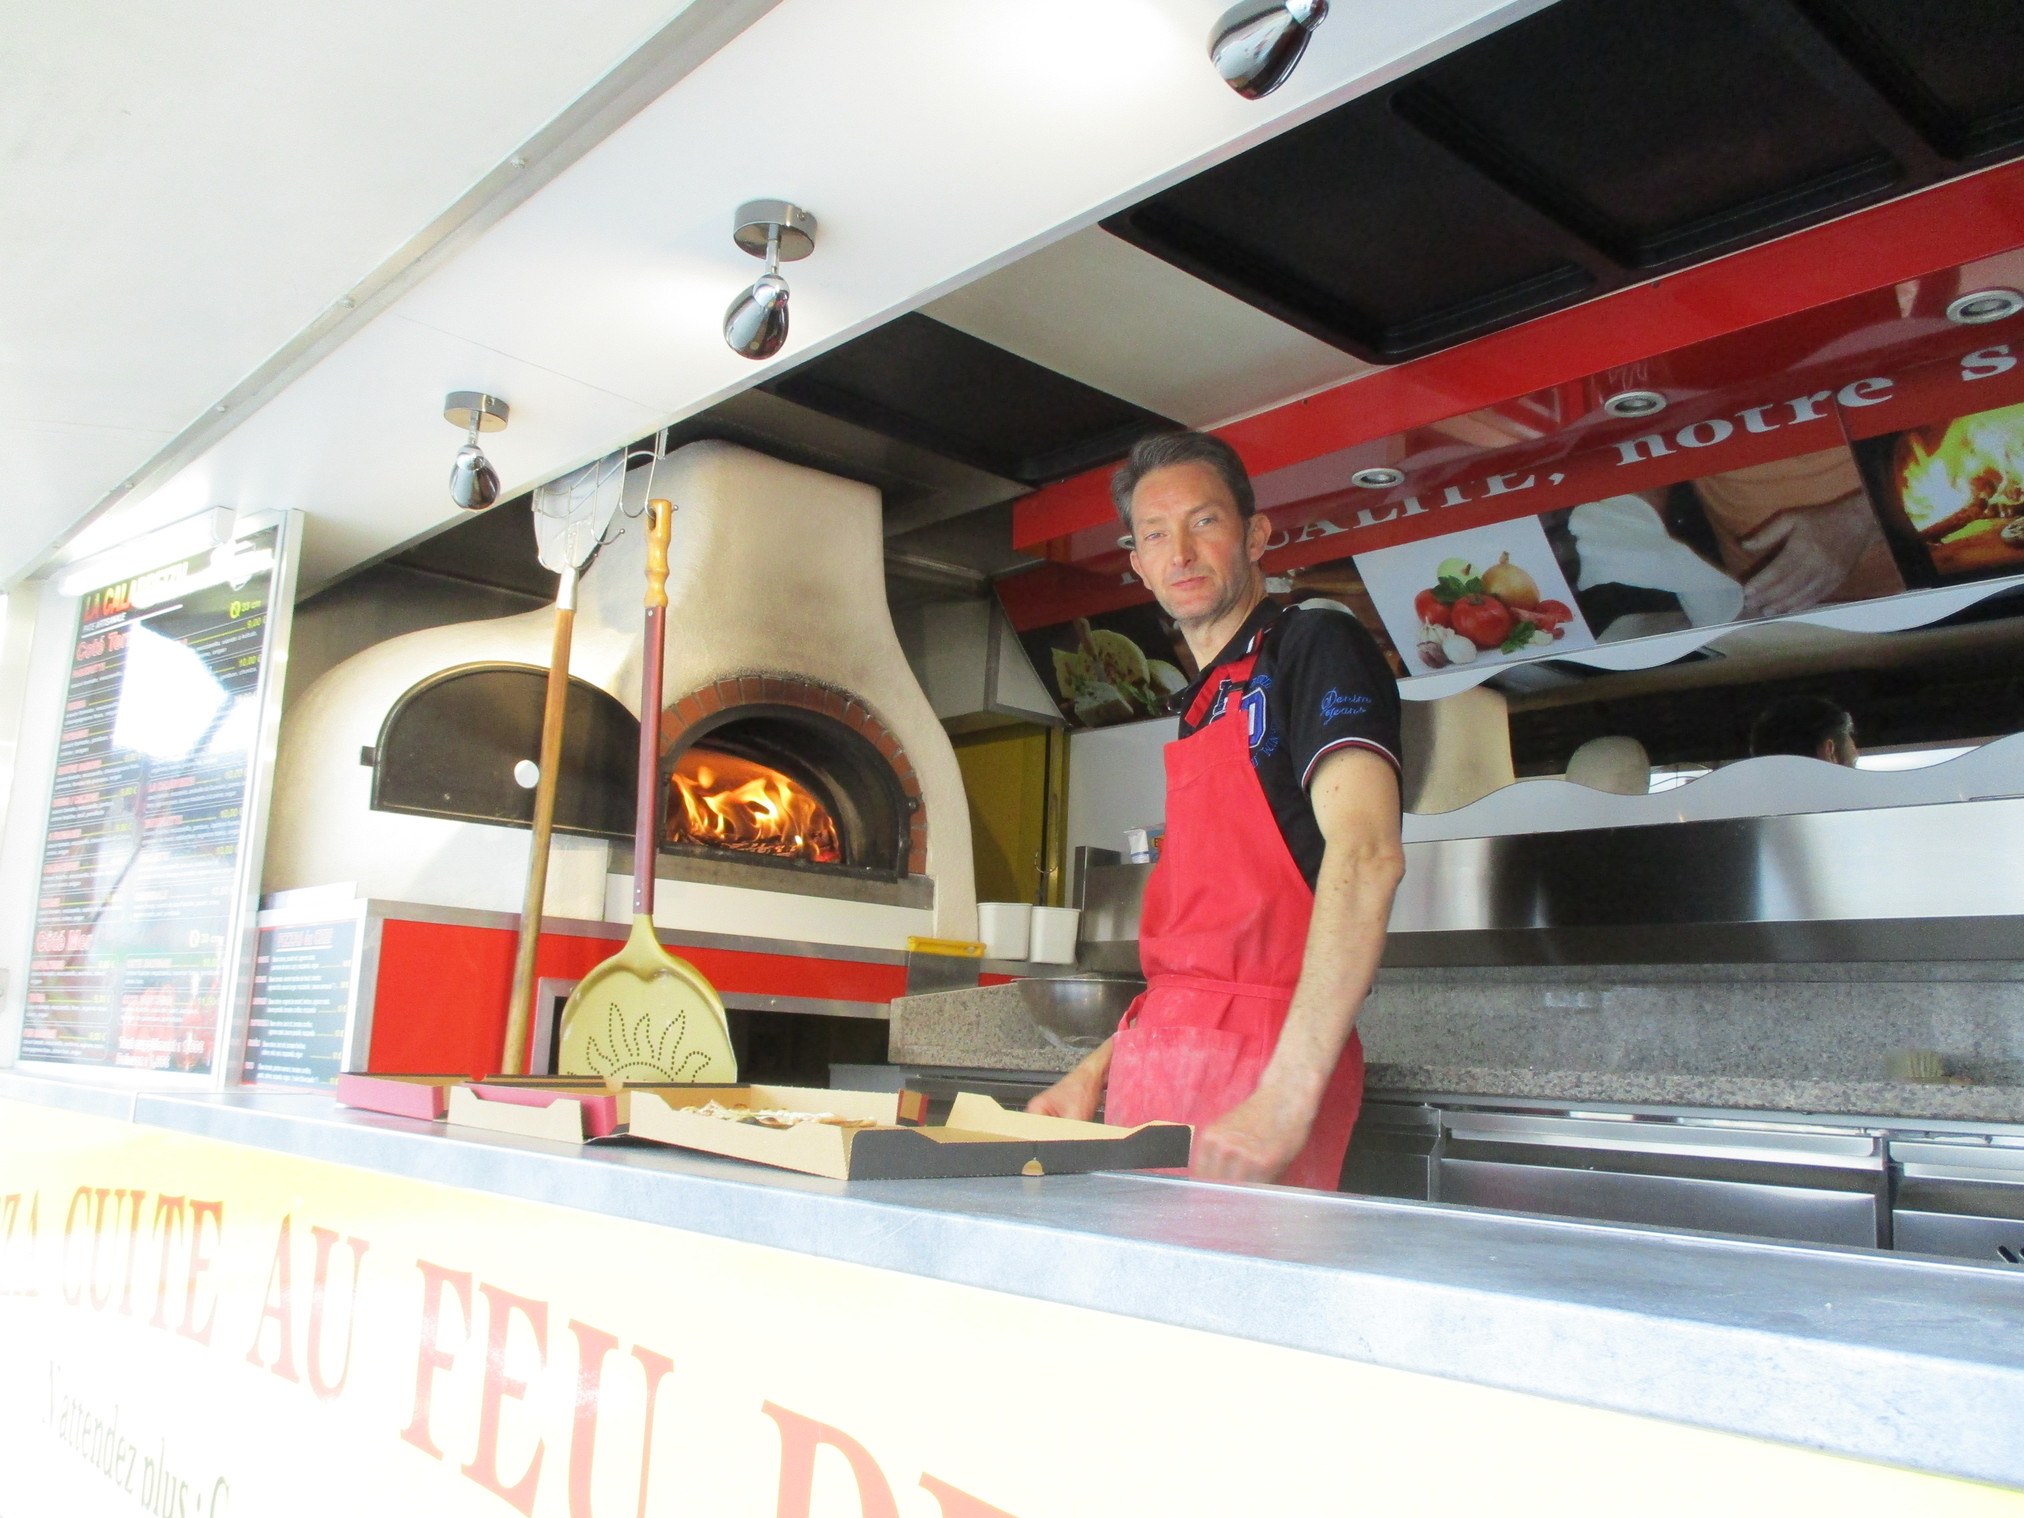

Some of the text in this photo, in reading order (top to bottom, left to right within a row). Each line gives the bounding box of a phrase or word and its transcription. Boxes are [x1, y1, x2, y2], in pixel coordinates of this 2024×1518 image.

[1612, 376, 1895, 467] notre
[61, 1184, 225, 1347] CUITE
[245, 1212, 371, 1402] AU
[400, 1257, 675, 1518] FEU
